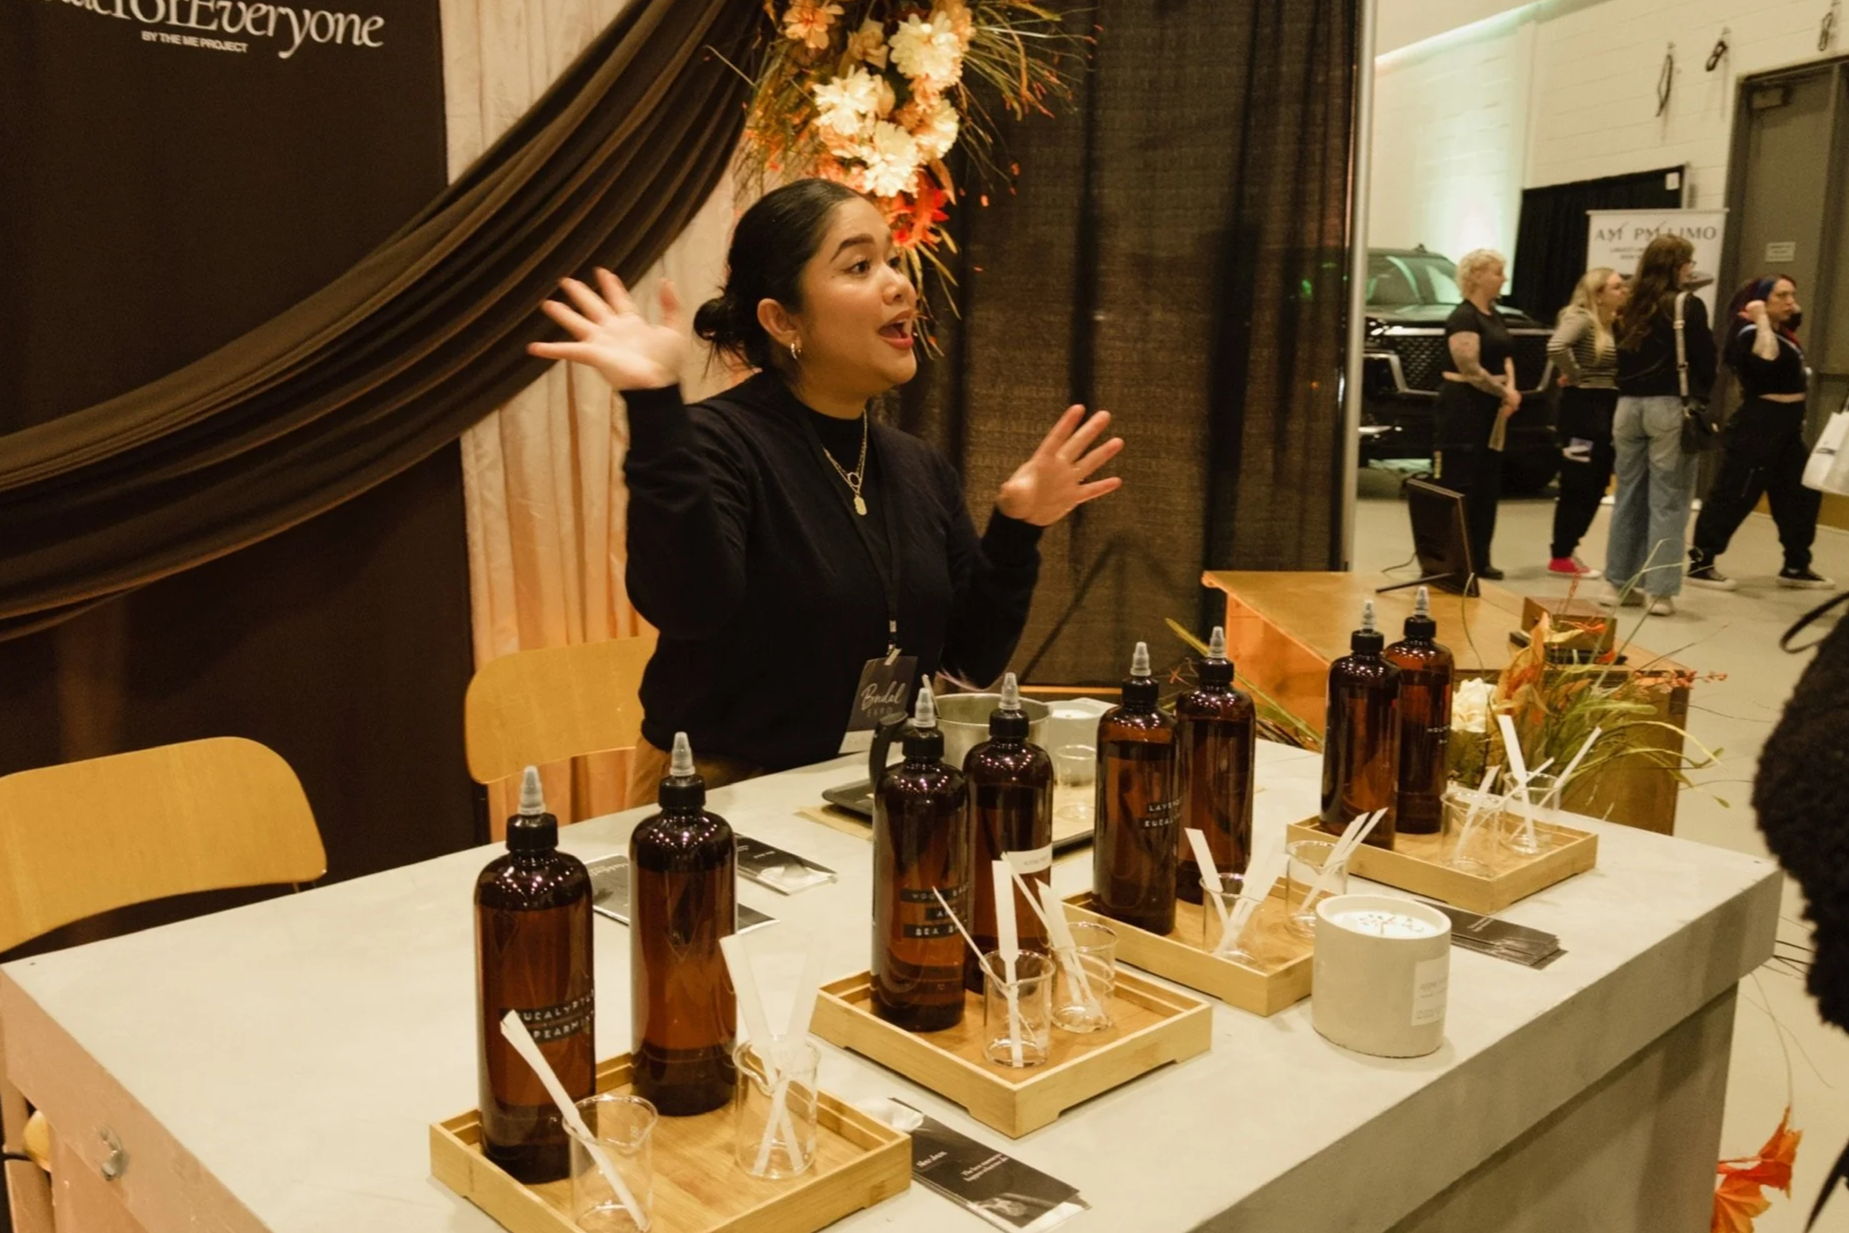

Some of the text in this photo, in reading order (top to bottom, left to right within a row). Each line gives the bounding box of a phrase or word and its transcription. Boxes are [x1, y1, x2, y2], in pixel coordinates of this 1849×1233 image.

[141, 30, 248, 54] BY THE ME PROJECT
[516, 988, 594, 1021] UCALYPTUS
